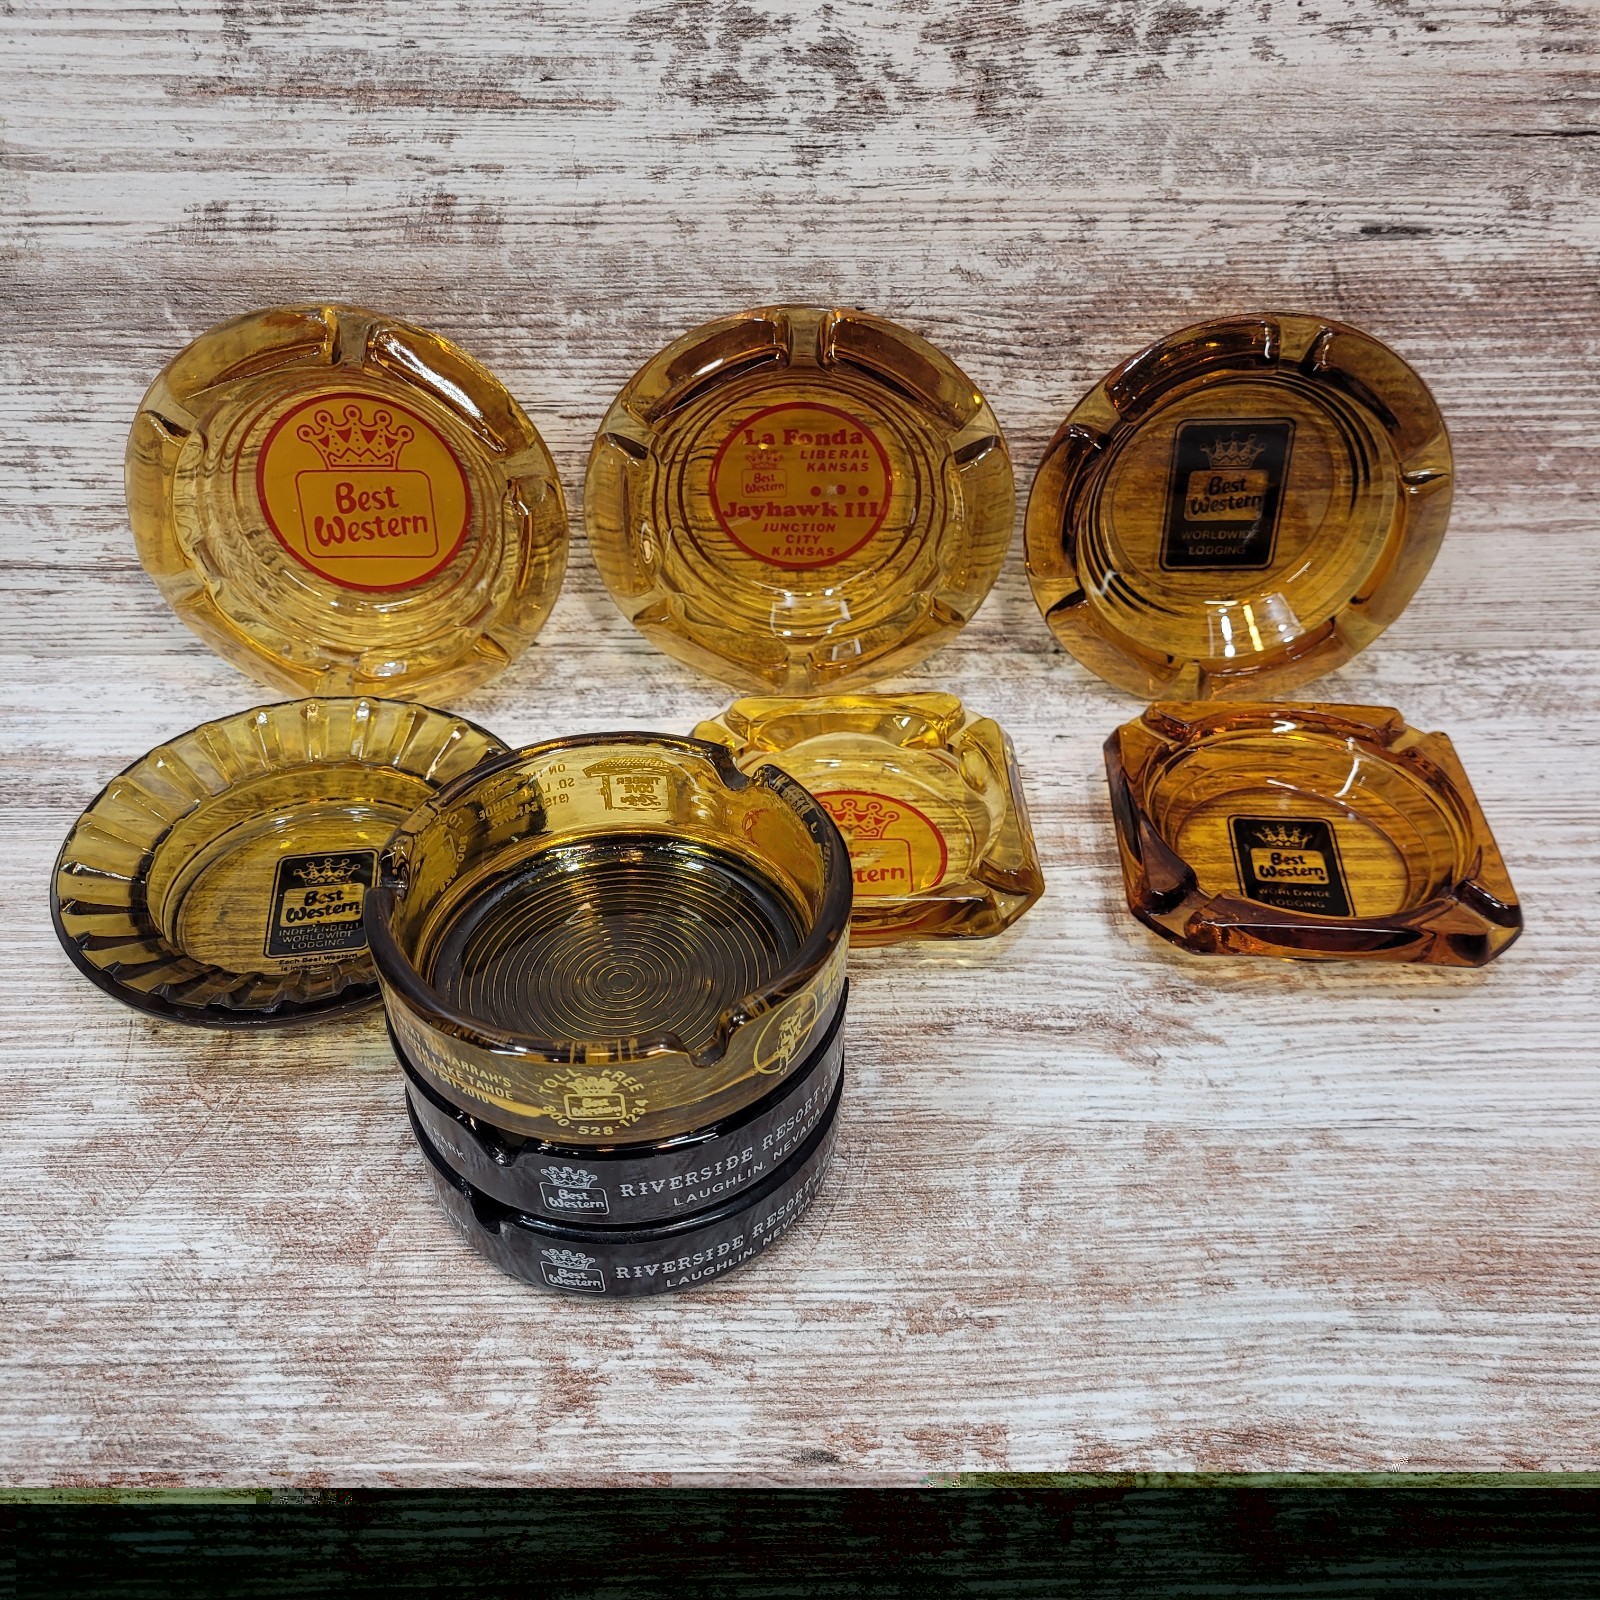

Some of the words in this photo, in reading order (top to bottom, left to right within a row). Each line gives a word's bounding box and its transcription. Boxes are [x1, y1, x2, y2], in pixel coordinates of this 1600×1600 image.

[743, 429, 775, 446] La
[783, 429, 863, 446] Fonda
[800, 450, 869, 459] LIBERAL
[806, 463, 869, 472] KANSAS
[753, 473, 775, 483] Best
[745, 483, 785, 494] Western
[1208, 476, 1246, 495] Best
[335, 482, 399, 514] Best
[723, 502, 838, 520] Jayhawk
[844, 502, 880, 518] III
[1191, 496, 1262, 515] Western
[314, 515, 428, 547] Western
[762, 523, 836, 532] JUNCTION
[785, 535, 821, 544] CITY
[1182, 530, 1260, 540] WORLDWIDE
[771, 547, 834, 556] KANSAS
[1188, 546, 1246, 555] LODGING
[1271, 853, 1306, 865] Best
[853, 867, 905, 883] tern
[1259, 865, 1323, 878] Western
[304, 890, 344, 906] Best
[1259, 888, 1332, 897] WORLDWIDE
[1269, 899, 1325, 908] LODGING
[286, 902, 360, 922] Western
[278, 922, 359, 936] INDEPENDENT
[282, 930, 354, 943] WORLDWIDE
[291, 939, 345, 950] LODGING
[443, 1053, 502, 1088] HARRAH'S
[432, 1055, 464, 1081] LAKE
[466, 1074, 514, 1101] TAHOE
[538, 1068, 582, 1094] TOLL
[601, 1069, 645, 1093] FREE
[773, 1108, 820, 1160] NEVADA
[619, 1147, 753, 1197] RIVERSIDE
[762, 1085, 820, 1150] RESORT
[558, 1189, 590, 1200] Best
[549, 1197, 605, 1209] Western
[615, 1235, 744, 1279] RIVERSIDE
[752, 1176, 812, 1239] RESORT
[762, 1196, 811, 1247] NEVADA
[558, 1268, 588, 1279] Best
[549, 1274, 602, 1288] Western
